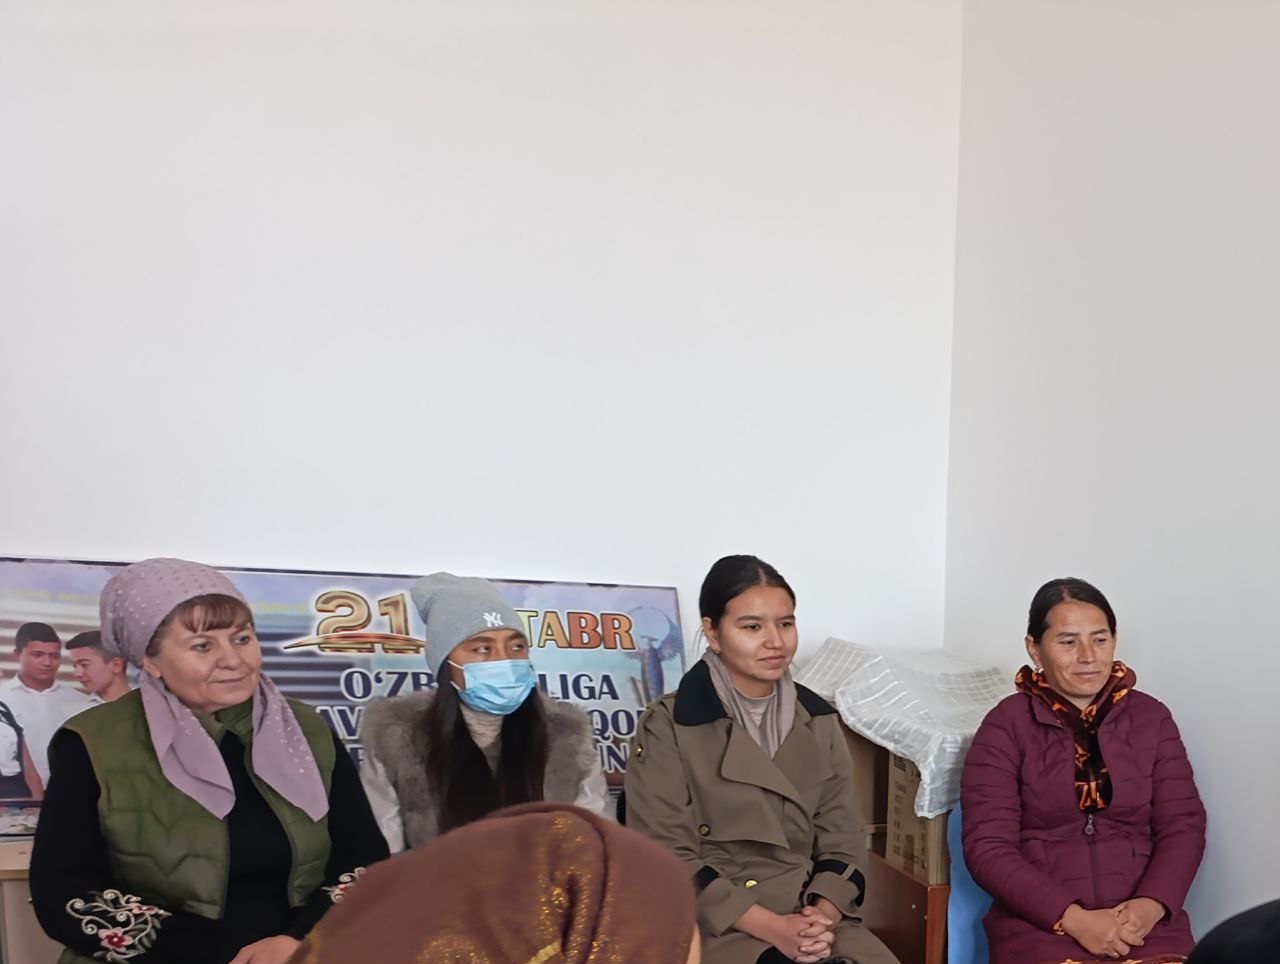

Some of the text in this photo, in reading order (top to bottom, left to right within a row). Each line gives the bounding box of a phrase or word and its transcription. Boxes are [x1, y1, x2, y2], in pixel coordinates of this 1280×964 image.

[315, 590, 636, 654] 21 TABR
[538, 673, 620, 701] LIGA
